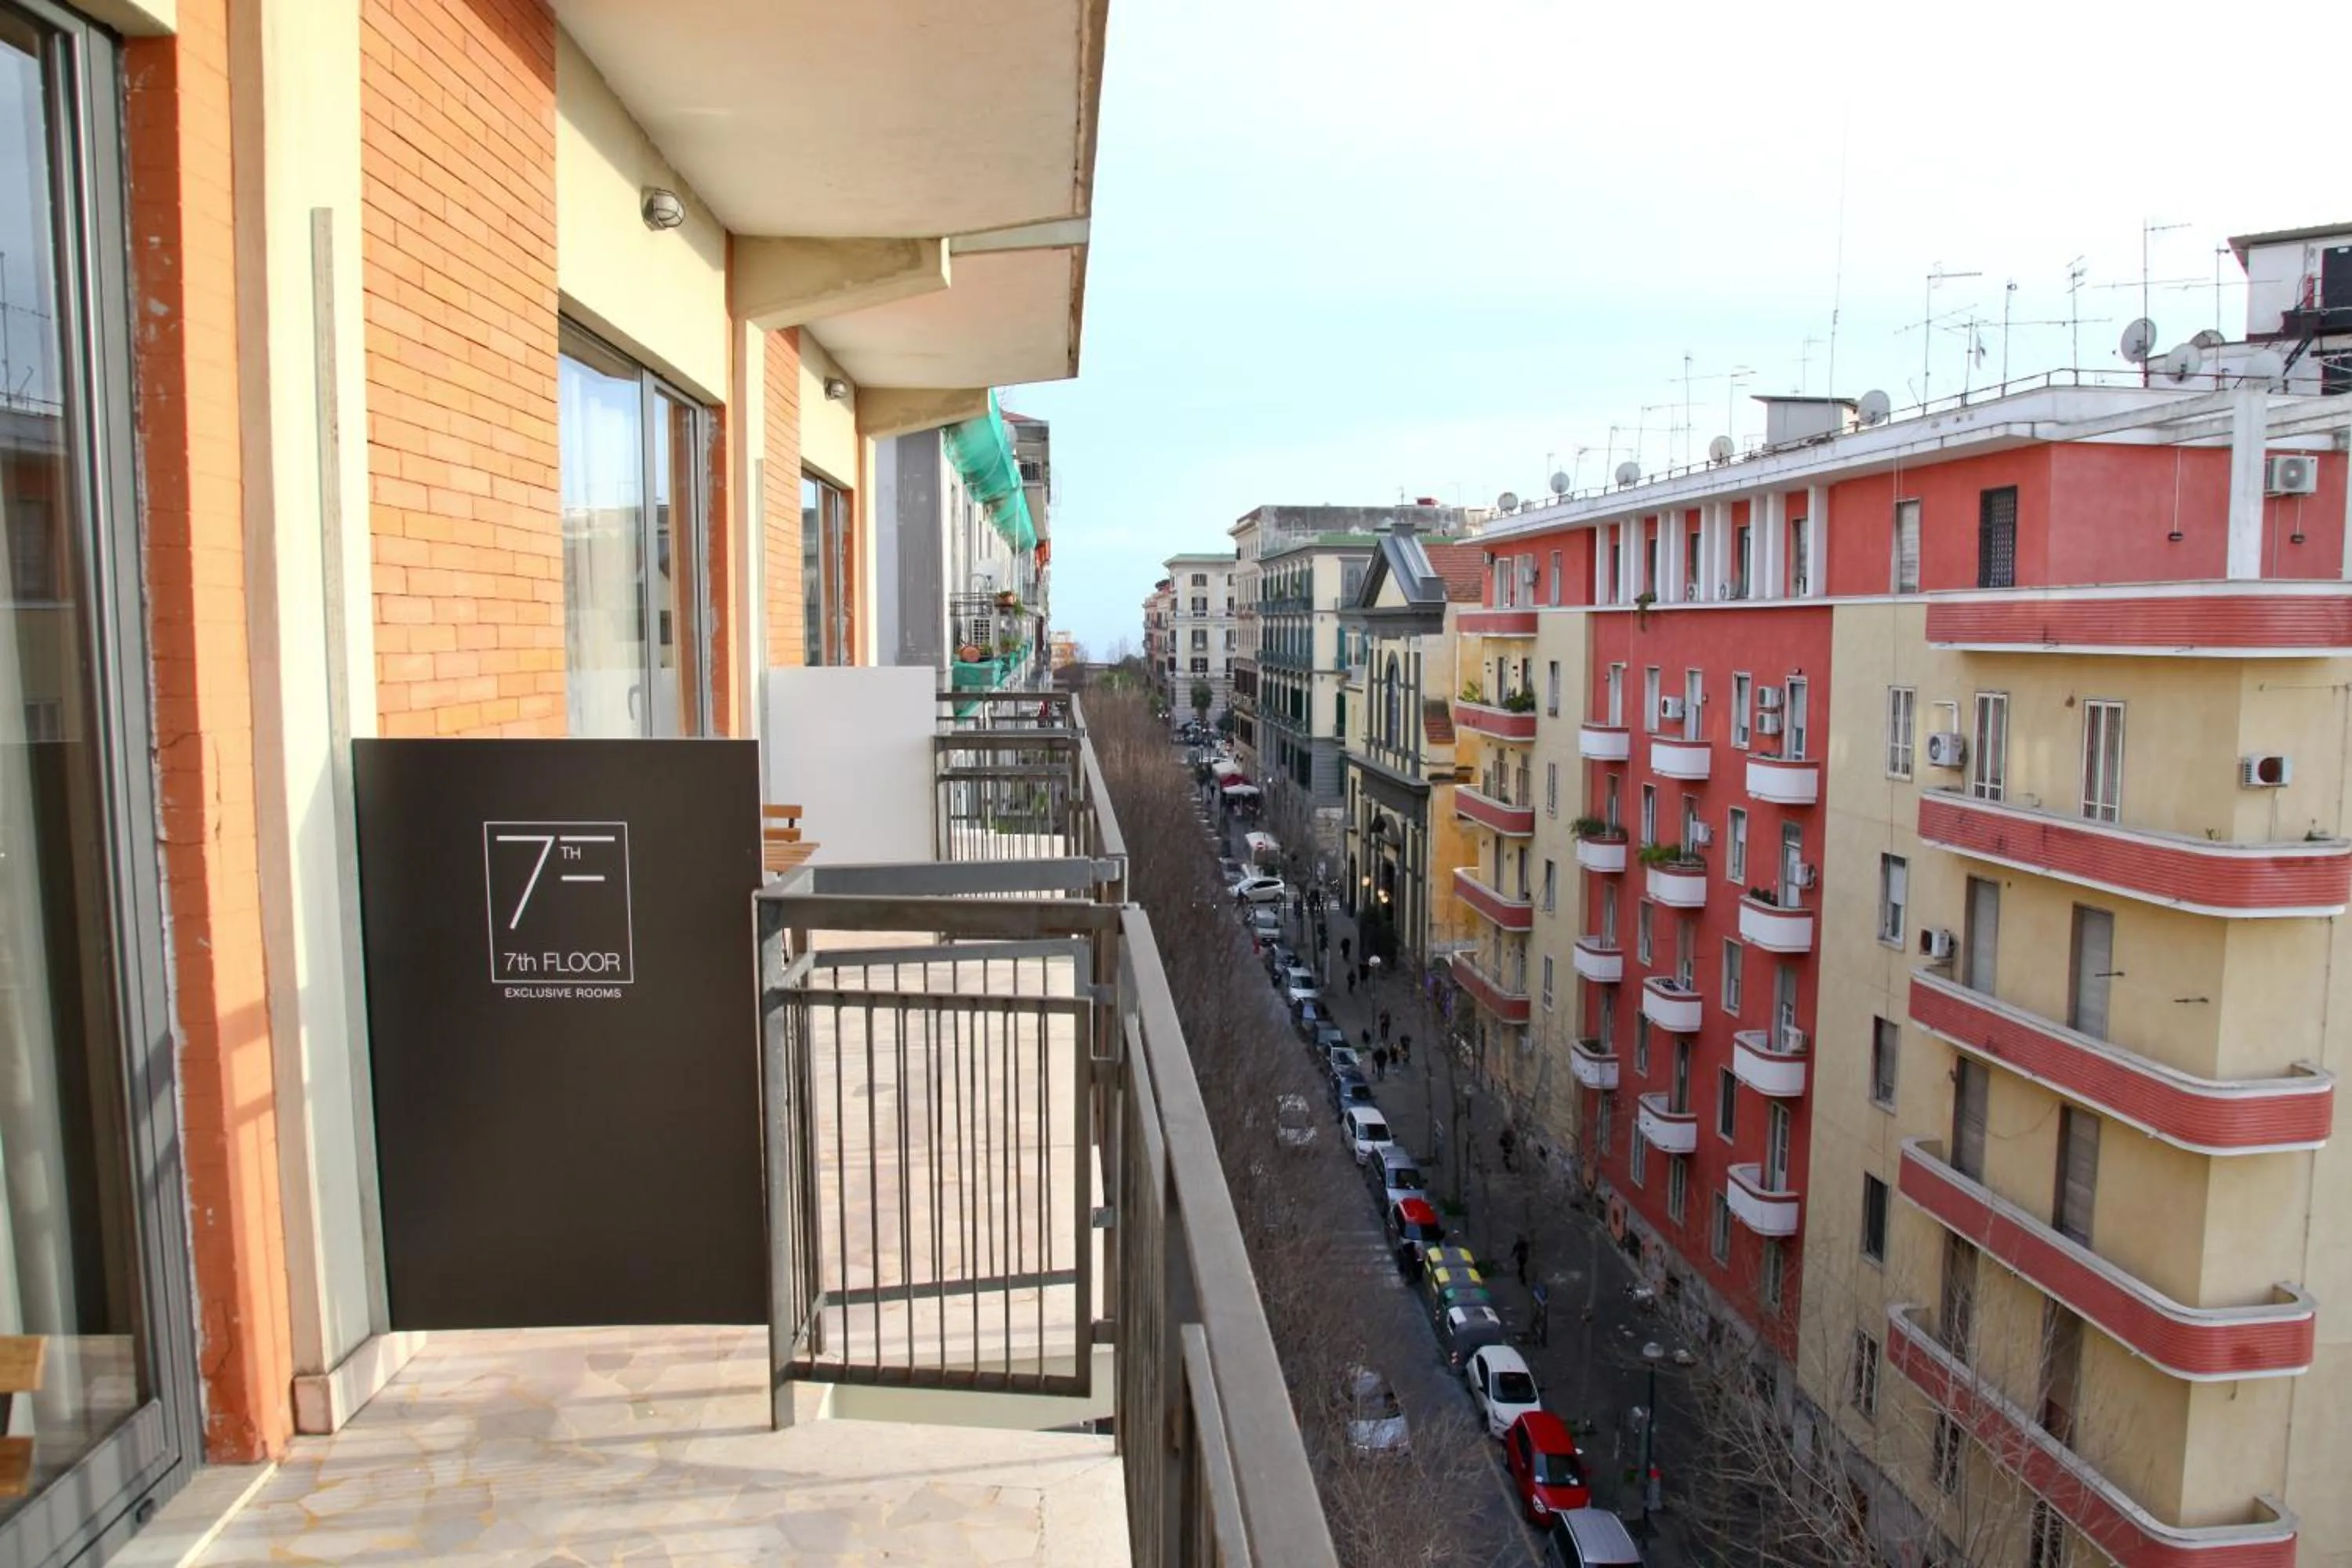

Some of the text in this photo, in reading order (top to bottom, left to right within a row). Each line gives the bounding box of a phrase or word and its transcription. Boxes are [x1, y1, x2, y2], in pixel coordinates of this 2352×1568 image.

[561, 846, 582, 860] TH
[503, 952, 621, 972] 7th FLOOR
[504, 988, 622, 998] EXCLUSIVE ROOMS
